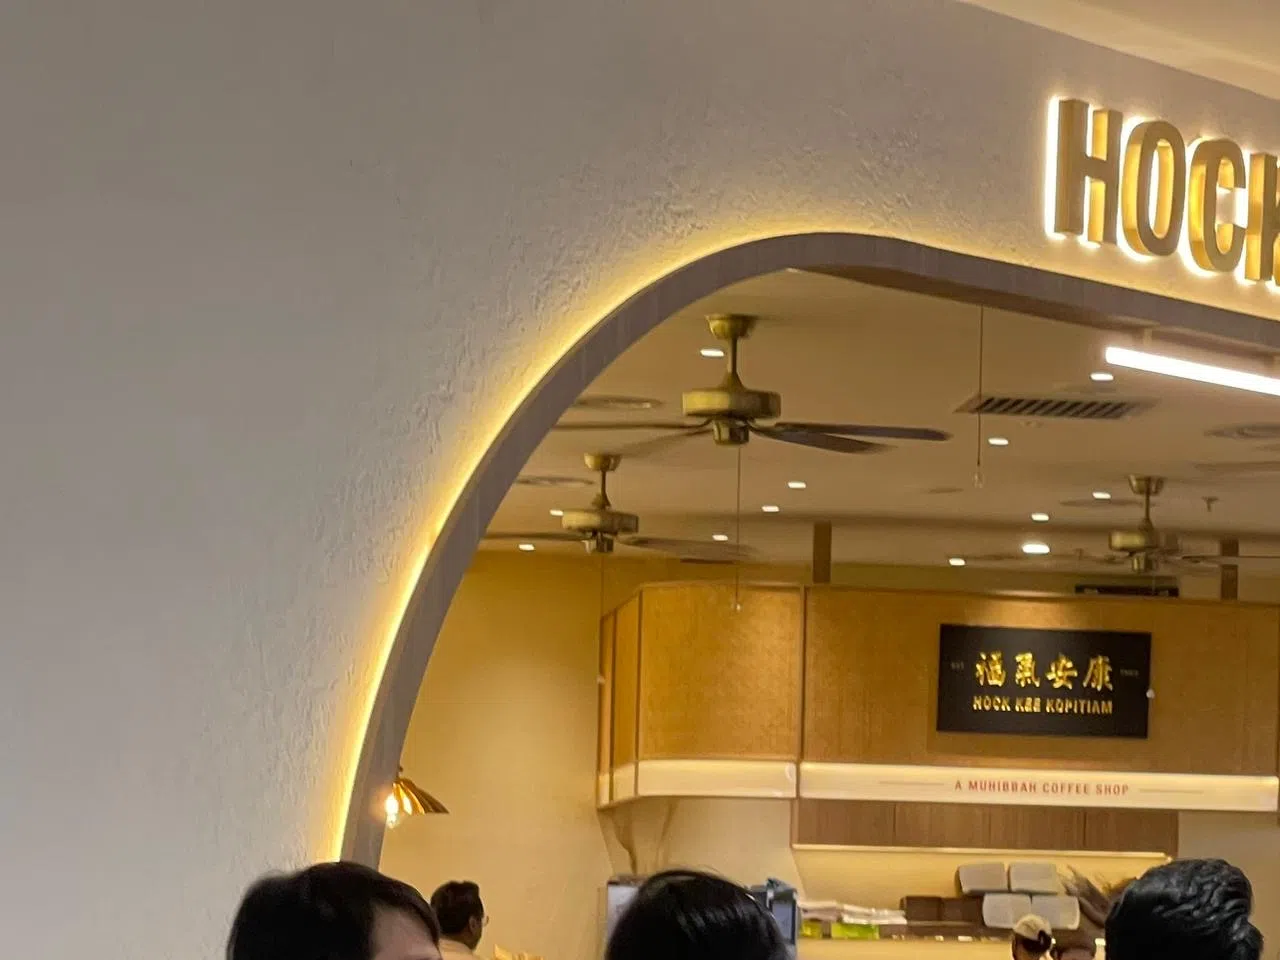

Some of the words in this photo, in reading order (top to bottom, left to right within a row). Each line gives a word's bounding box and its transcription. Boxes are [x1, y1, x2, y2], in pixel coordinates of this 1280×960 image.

[973, 695, 1011, 712] HOCK
[1015, 697, 1041, 713] KEE
[1045, 698, 1113, 715] KOPITIAM
[954, 780, 963, 791] A
[968, 780, 1037, 793] MUHIBBAH
[1042, 782, 1089, 795] COFFEE
[1096, 783, 1130, 796] SHOP
